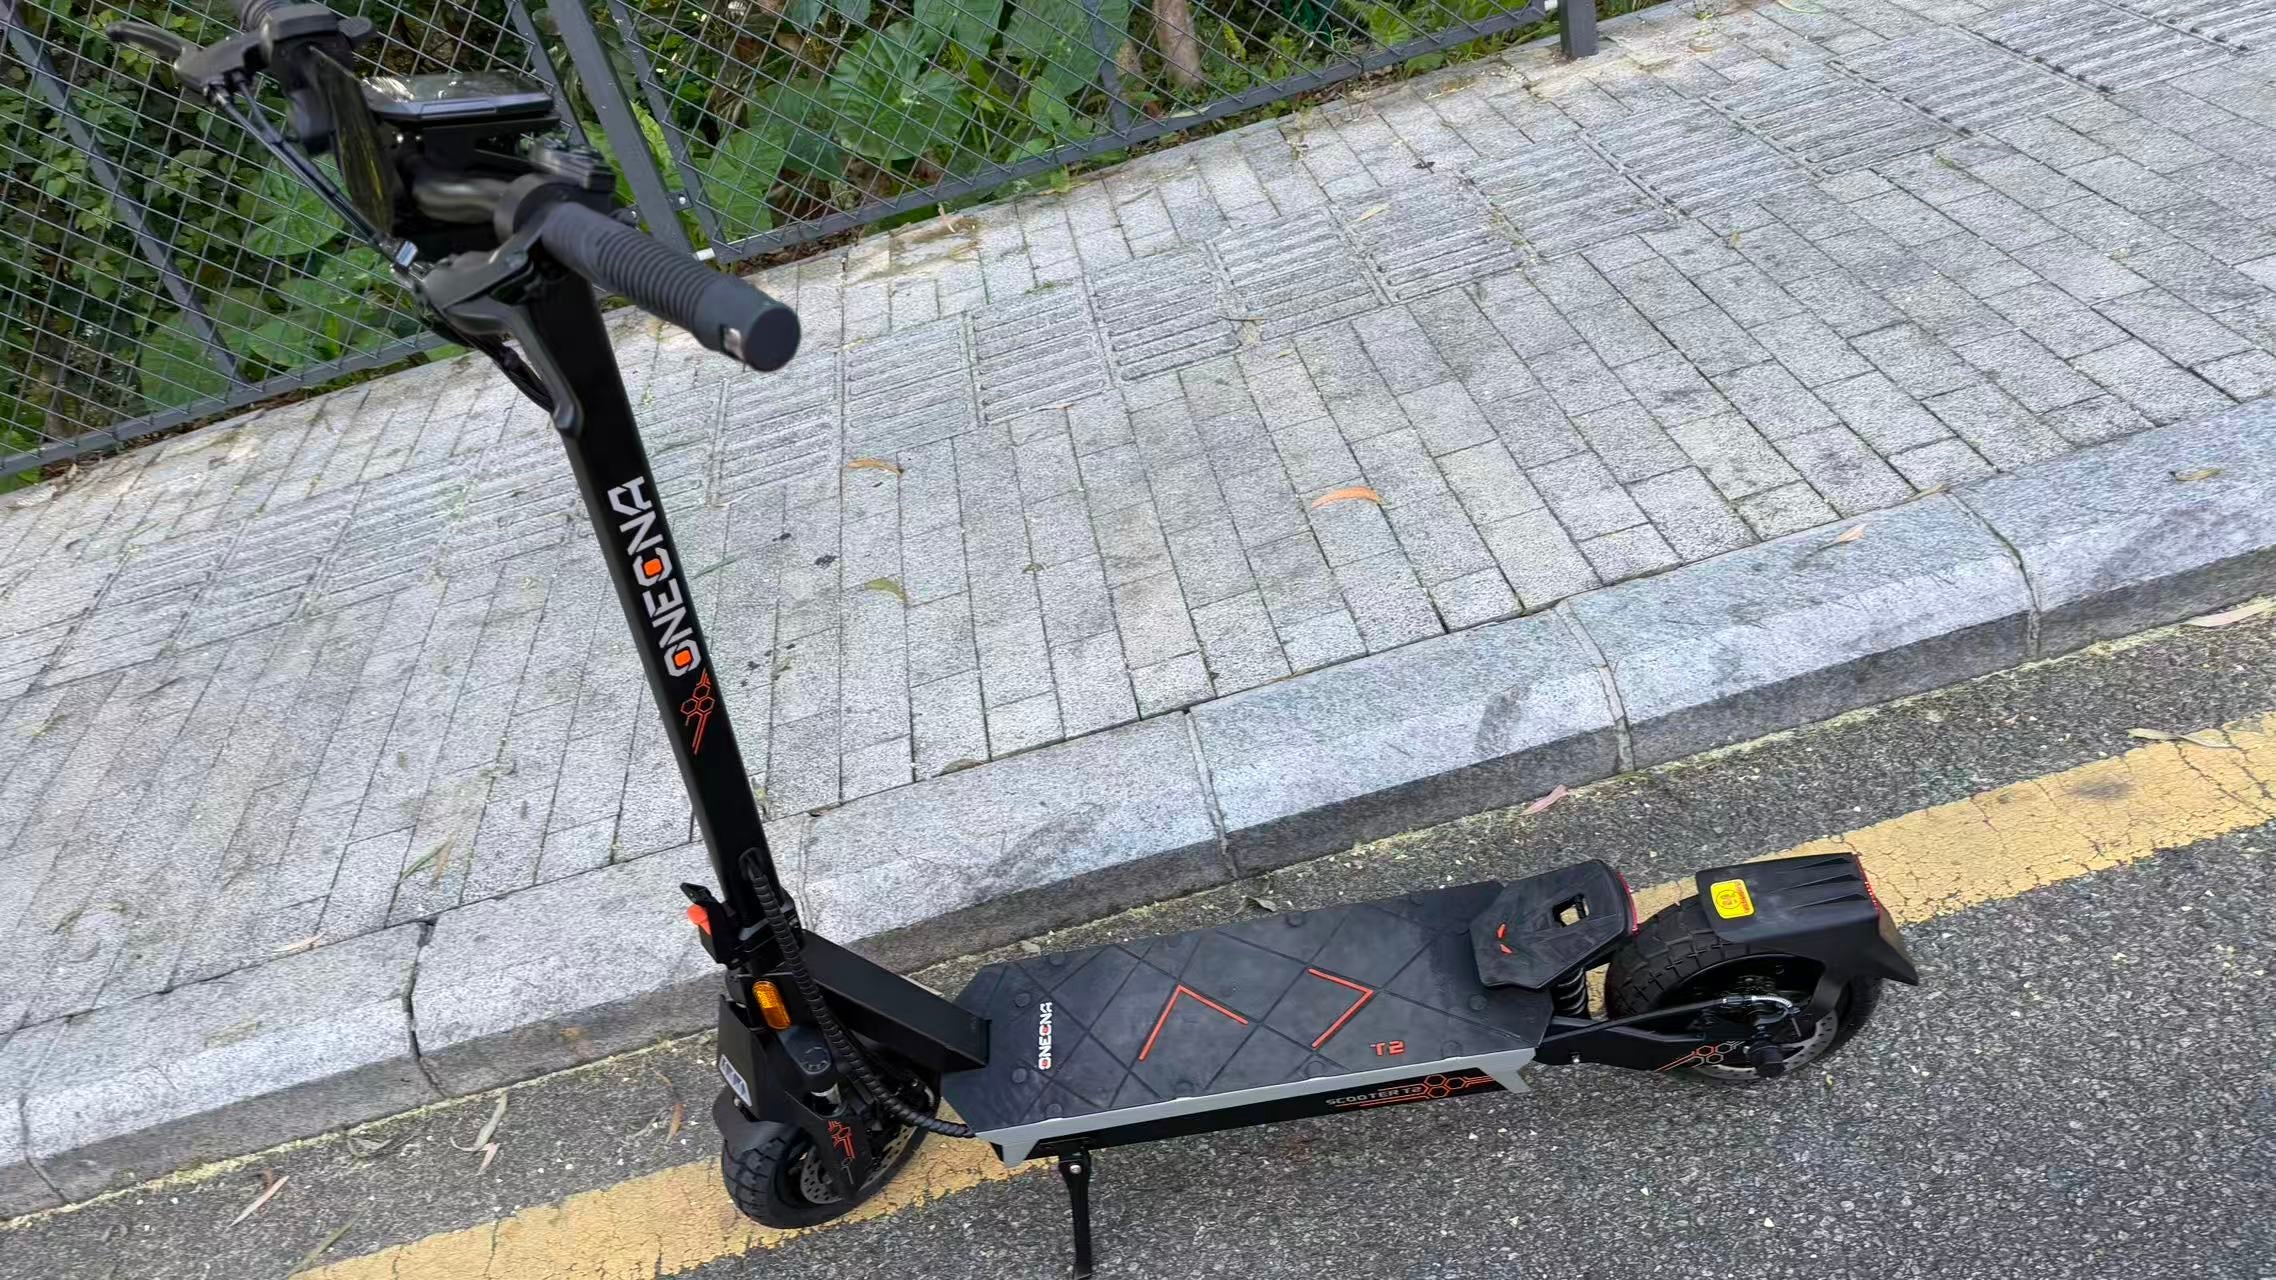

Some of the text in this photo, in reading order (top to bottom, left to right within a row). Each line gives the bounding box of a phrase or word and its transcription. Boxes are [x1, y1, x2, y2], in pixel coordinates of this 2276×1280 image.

[607, 476, 701, 677] ONECNA
[1038, 1001, 1053, 1070] ONECNA
[1369, 1040, 1405, 1056] T2
[1325, 1086, 1423, 1105] SCOOTER T2
